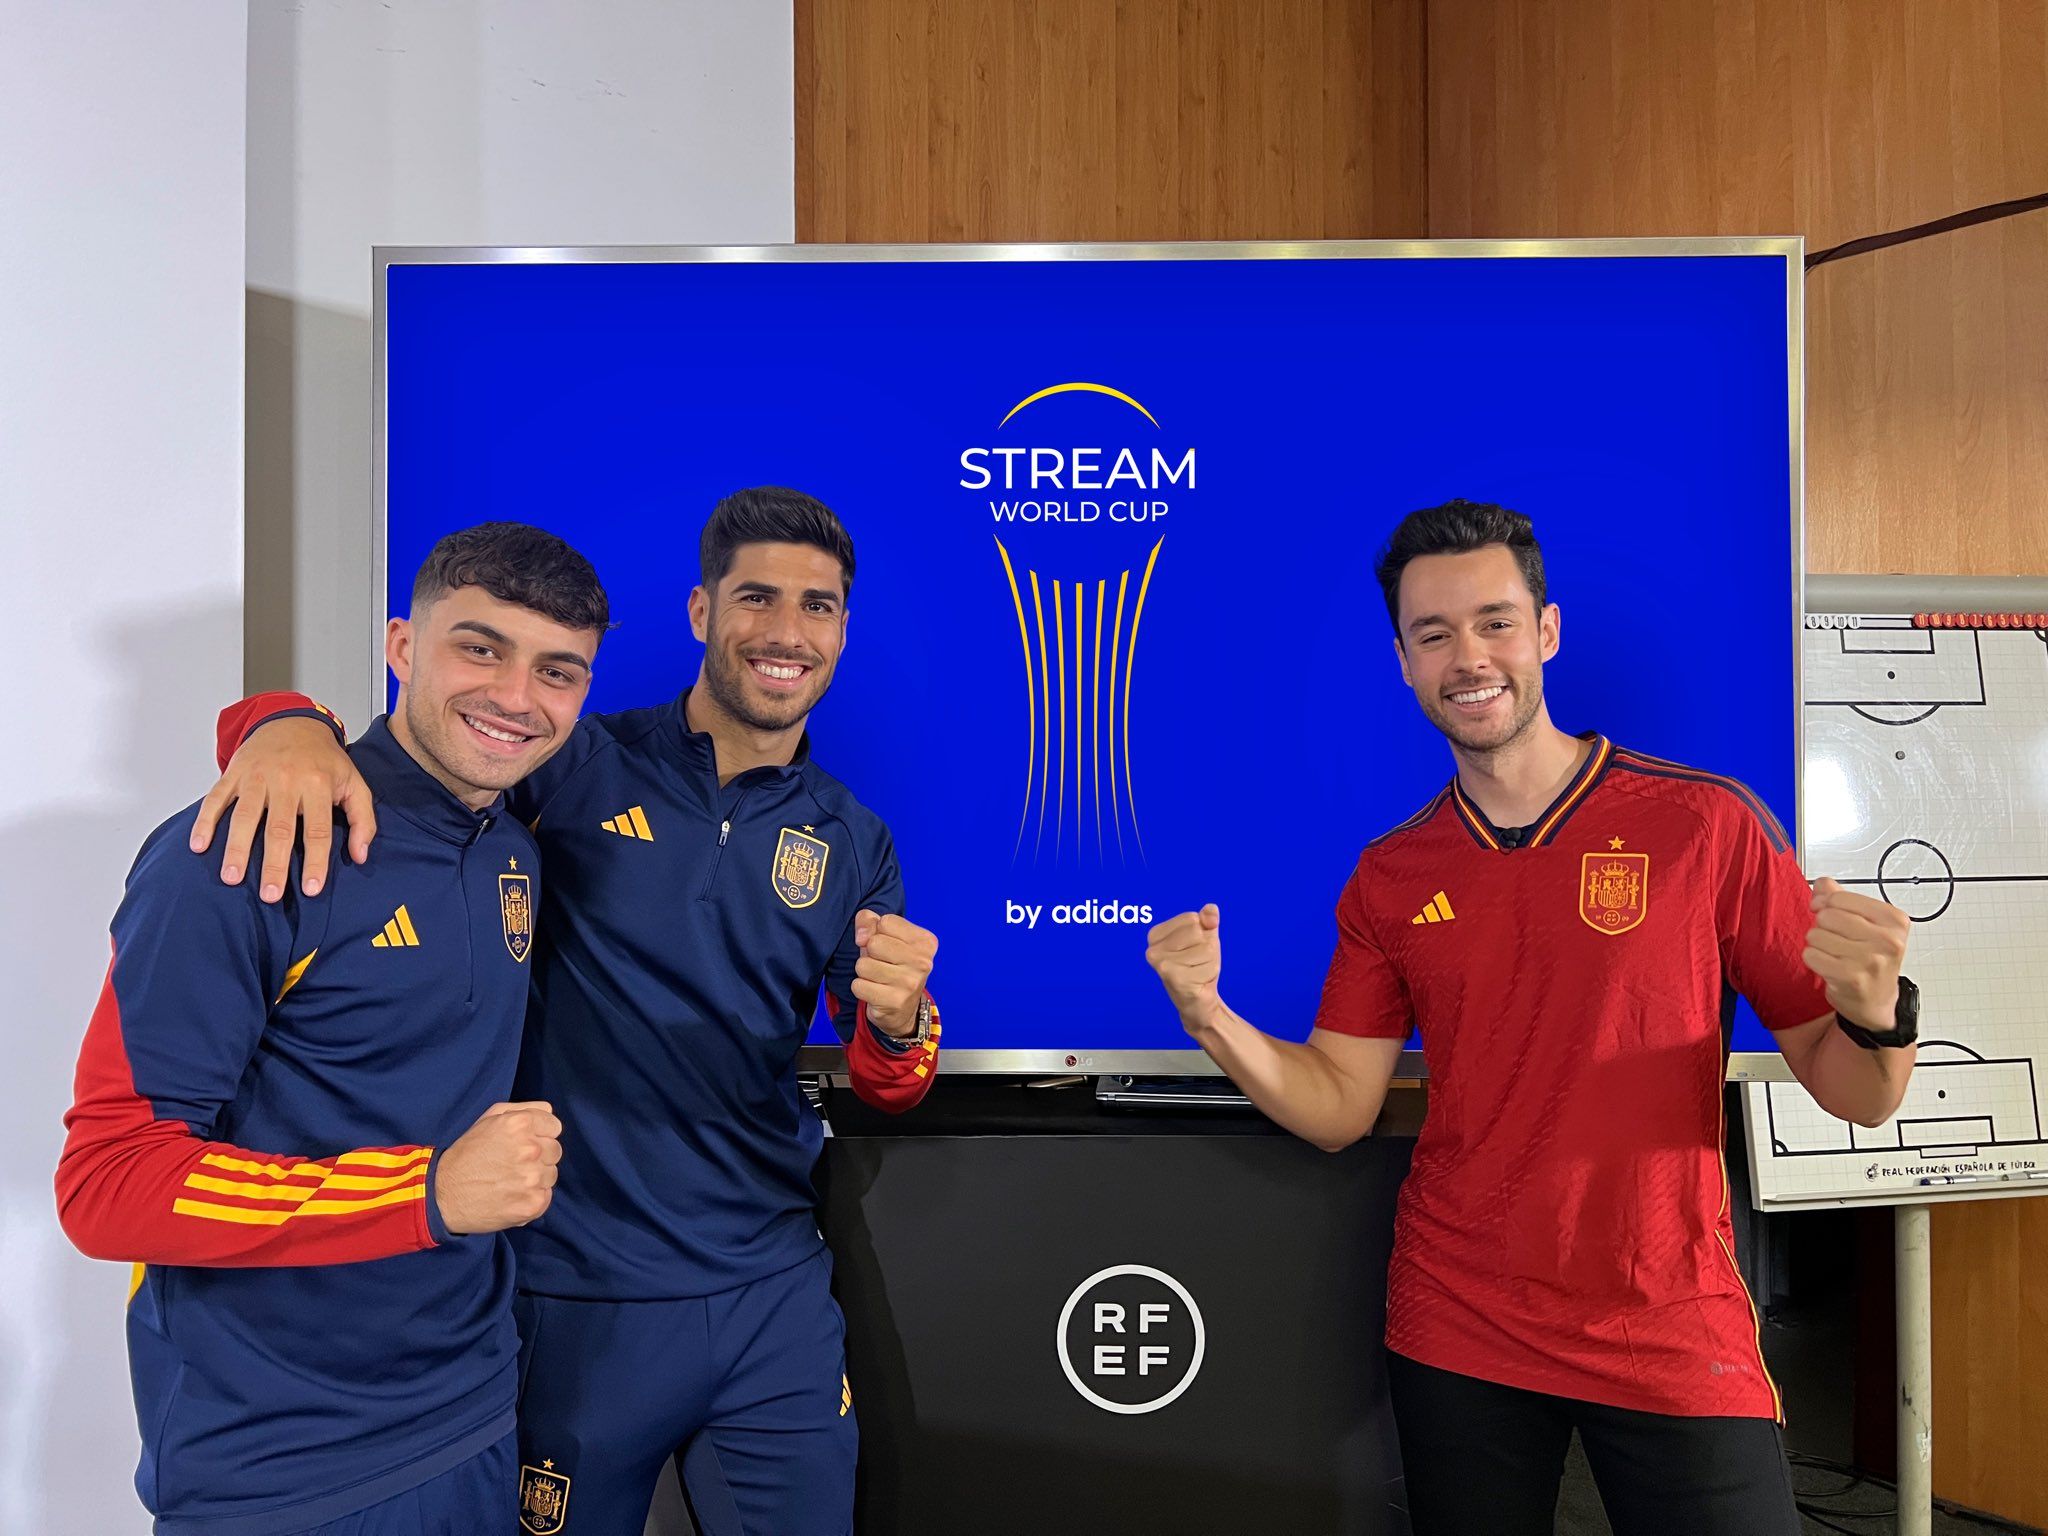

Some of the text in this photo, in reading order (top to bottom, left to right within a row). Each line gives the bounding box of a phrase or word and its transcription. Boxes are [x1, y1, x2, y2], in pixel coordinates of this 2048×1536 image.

[959, 447, 1196, 490] STREAM
[989, 501, 1169, 522] WORLD CUP
[1837, 616, 1845, 628] 10
[1851, 616, 1858, 627] 11
[1931, 613, 1940, 625] 10
[1006, 898, 1153, 930] by adidas
[1882, 1167, 1903, 1177] REAL
[1905, 1163, 1950, 1176] FEDERACIÓN
[1955, 1161, 1994, 1174] ESPAÑOLA
[1997, 1162, 2007, 1171] DE
